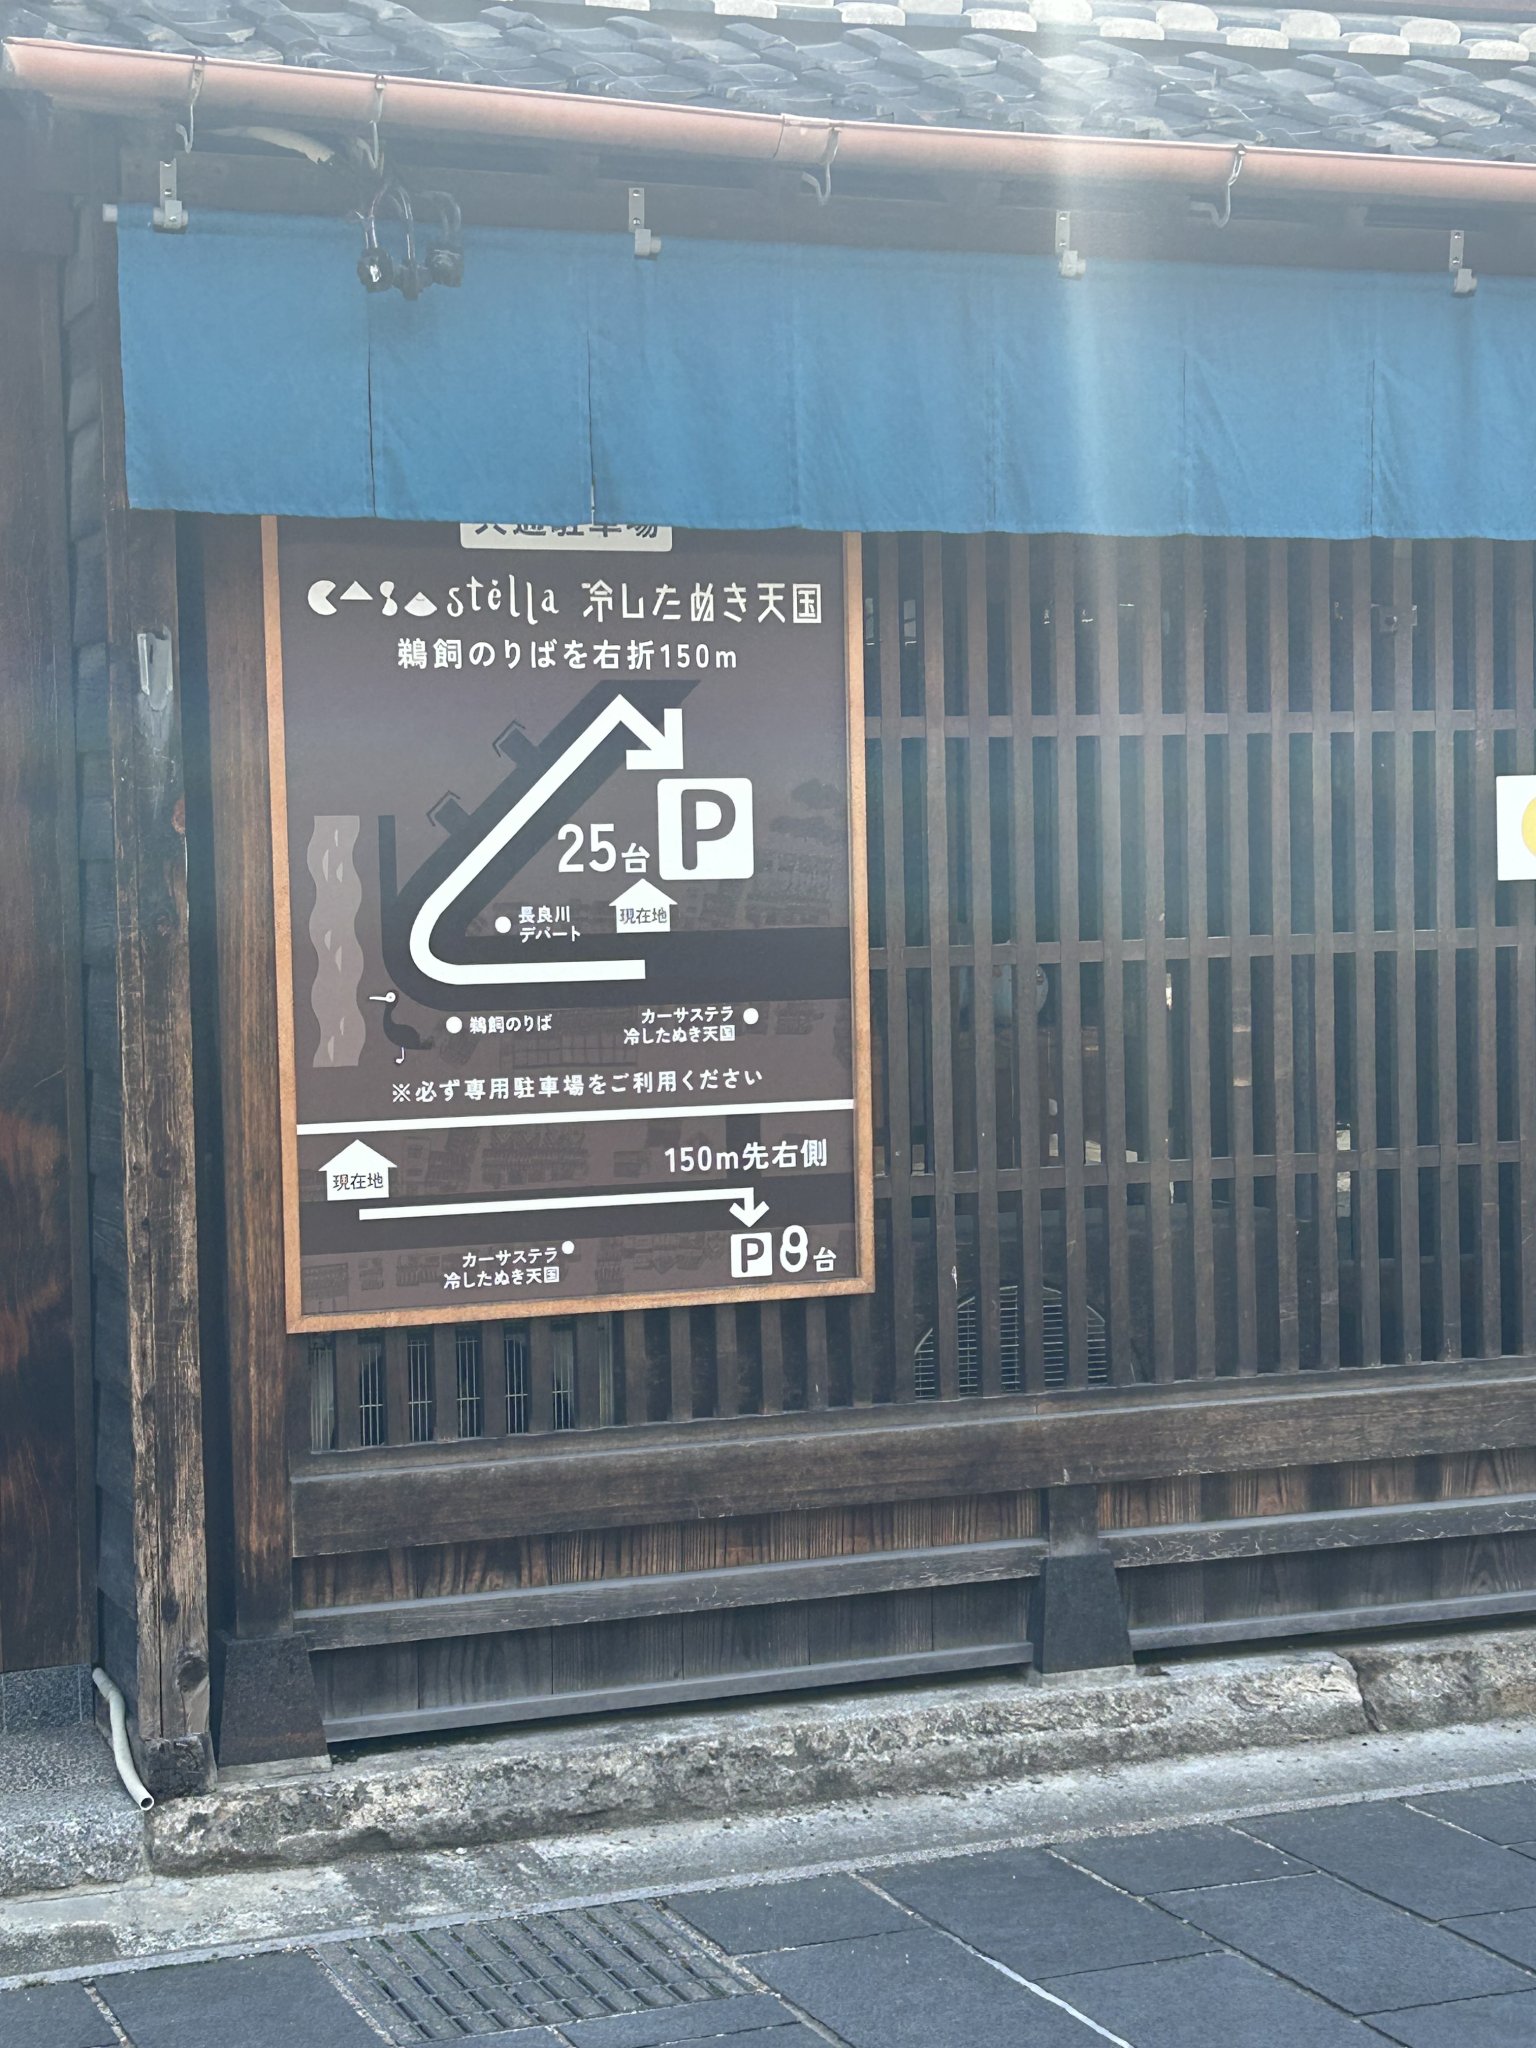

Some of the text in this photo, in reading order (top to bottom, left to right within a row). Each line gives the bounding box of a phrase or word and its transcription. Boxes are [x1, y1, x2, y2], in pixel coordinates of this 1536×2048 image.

[581, 579, 823, 624] 冷したぬき天国
[680, 788, 737, 871] P
[518, 905, 571, 924] 長良川
[619, 907, 668, 924] 現在地
[519, 925, 581, 943] デパート
[641, 1005, 734, 1025] カーサステラ
[623, 1024, 736, 1046] 冷したぬき天国
[664, 1138, 828, 1173] 150m先右側
[332, 1171, 385, 1191] 現在地
[461, 1246, 558, 1268] カーサステラ
[740, 1237, 765, 1273] P
[443, 1265, 560, 1290] 冷したぬき天国
